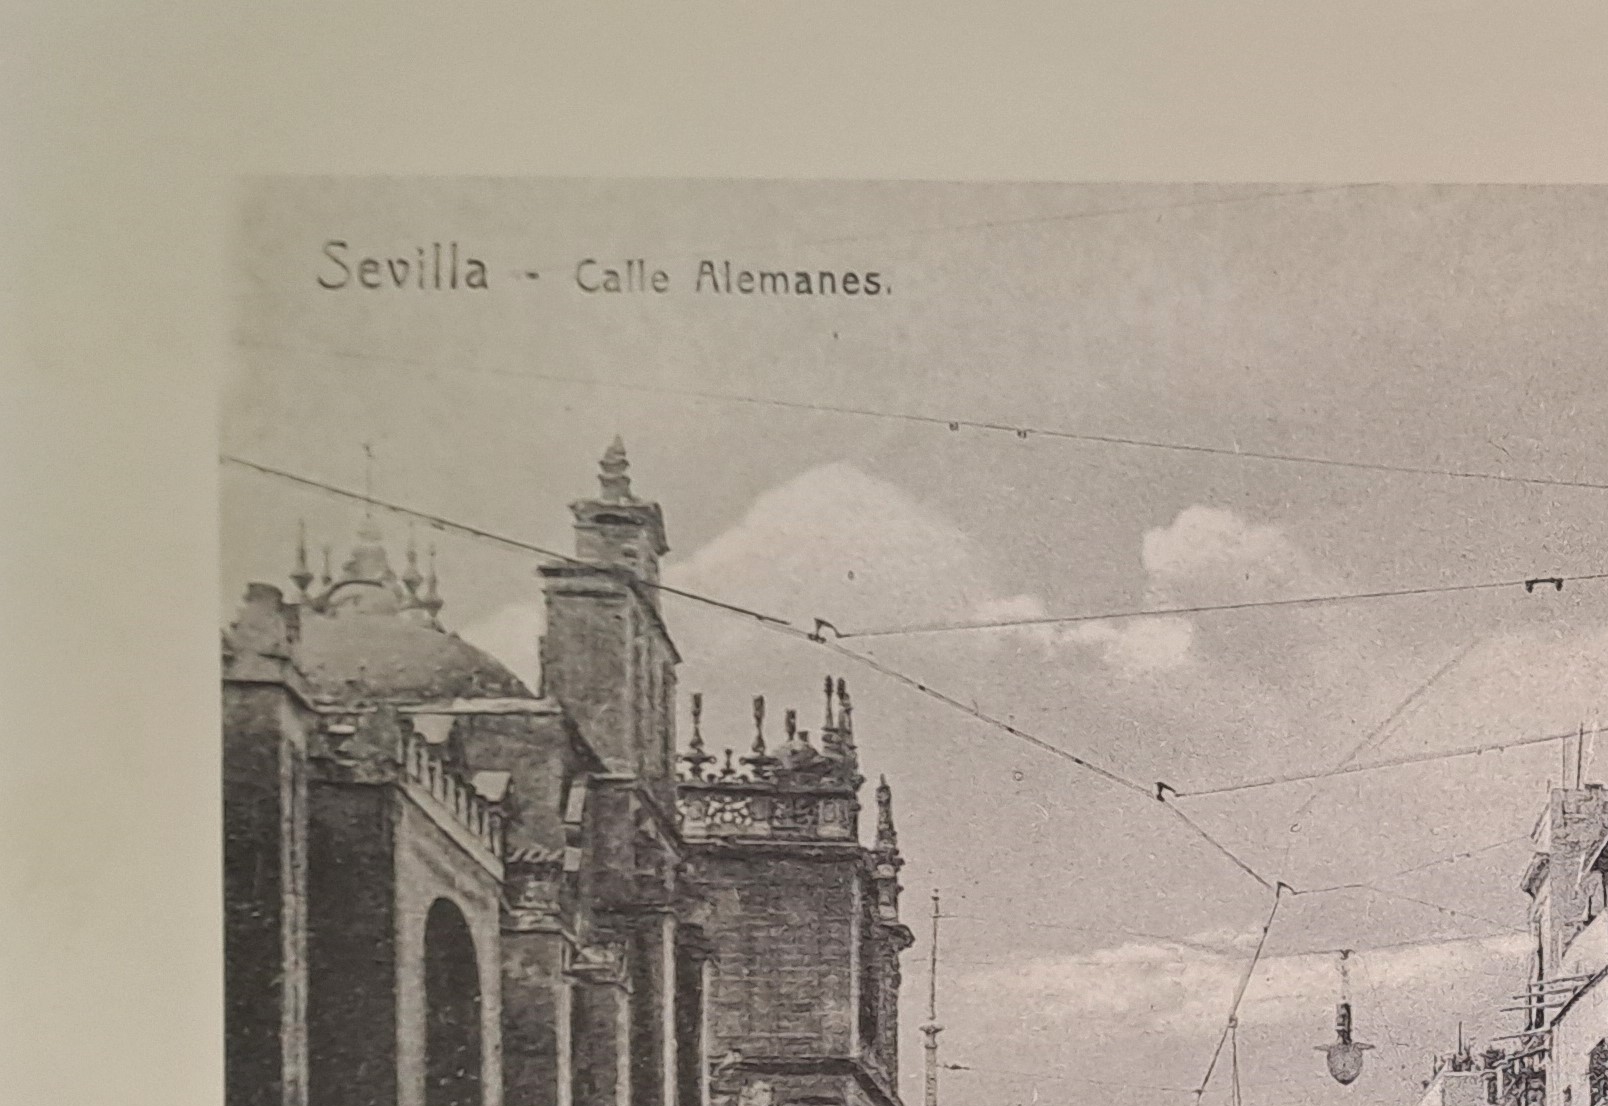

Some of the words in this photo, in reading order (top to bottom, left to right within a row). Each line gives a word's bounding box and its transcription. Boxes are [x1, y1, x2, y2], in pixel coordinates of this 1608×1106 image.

[316, 239, 489, 291] Sevilla
[575, 257, 670, 294] Calle
[695, 258, 893, 296] Alemanes.
